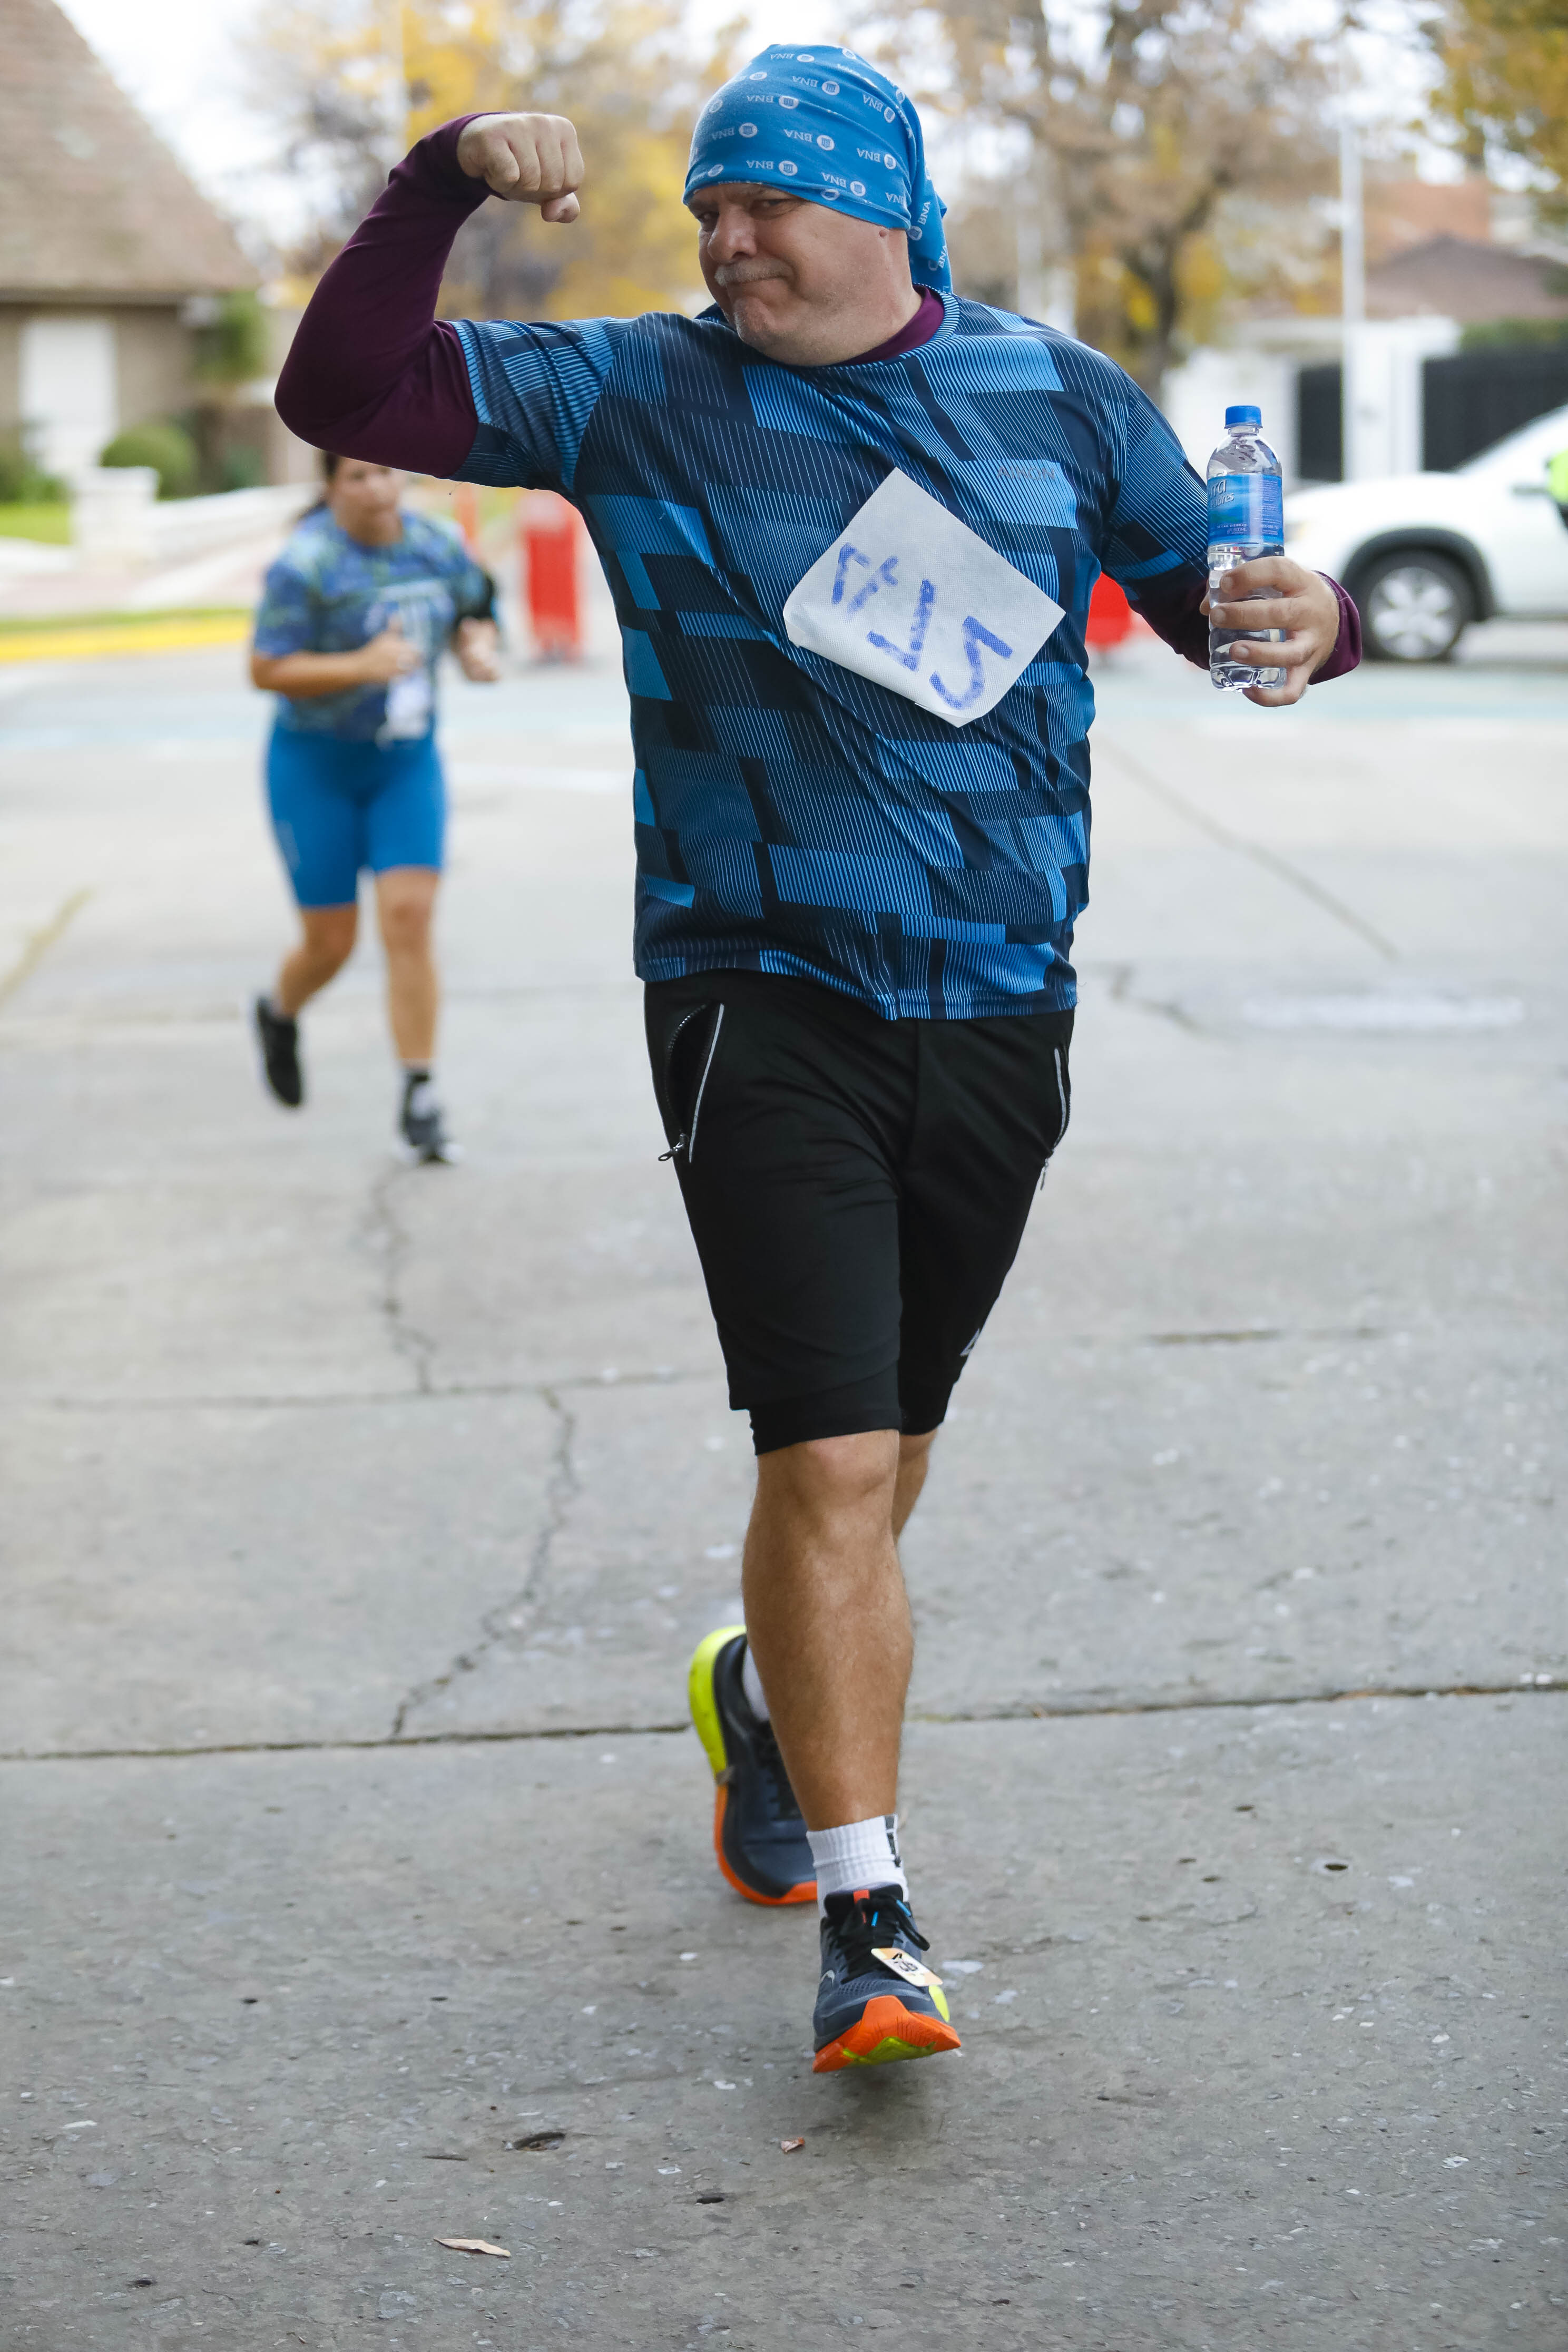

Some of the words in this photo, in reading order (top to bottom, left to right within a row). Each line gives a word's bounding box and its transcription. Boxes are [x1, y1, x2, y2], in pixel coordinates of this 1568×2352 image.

[792, 75, 819, 88] BNA
[746, 95, 774, 103] BNA
[863, 94, 885, 113] BNA
[711, 126, 735, 141] BNA
[783, 128, 813, 143] BNA
[856, 148, 881, 163] BNA
[746, 160, 774, 170] BNA
[821, 172, 847, 188] BNA
[917, 200, 931, 226] BNA
